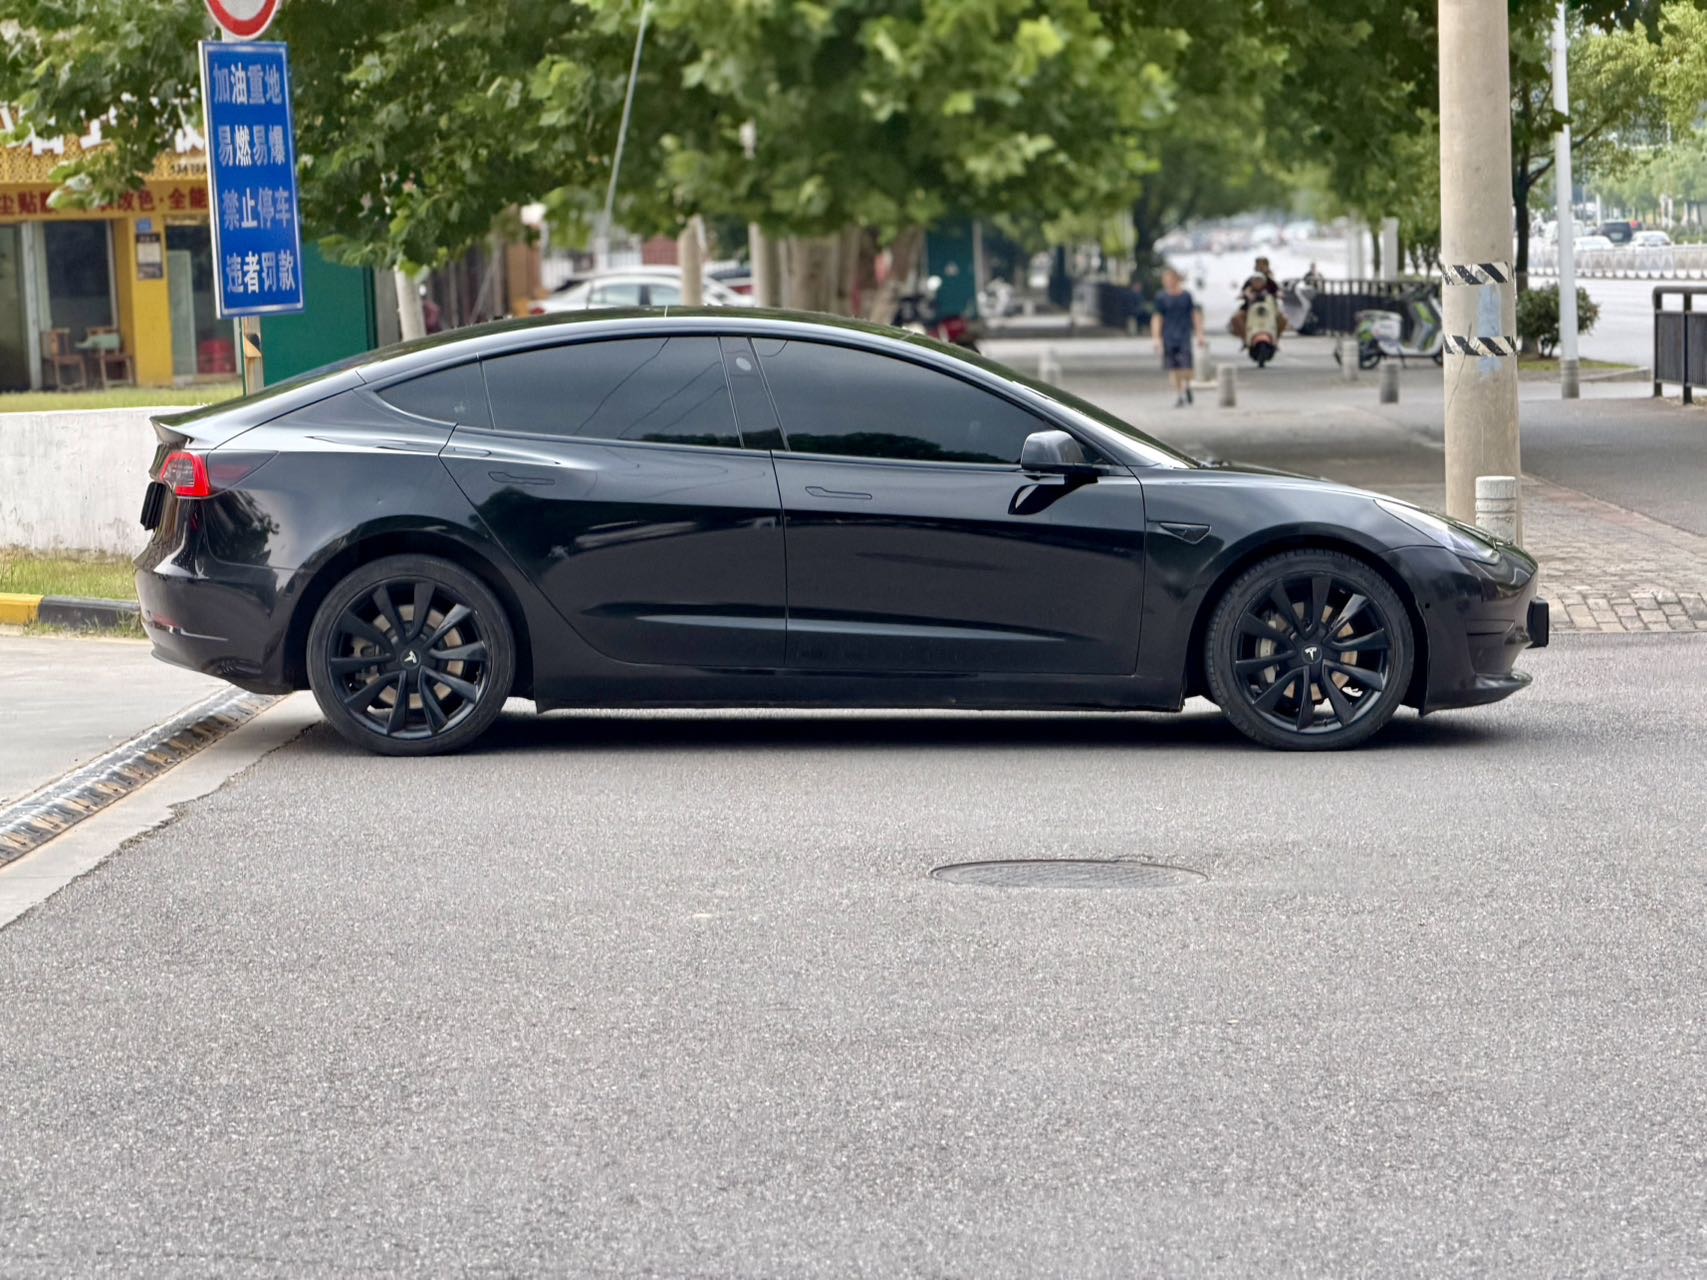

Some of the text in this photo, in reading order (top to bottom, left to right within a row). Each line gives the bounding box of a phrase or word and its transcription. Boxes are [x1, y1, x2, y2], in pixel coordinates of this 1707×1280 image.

[213, 62, 282, 105] 加油重地
[217, 124, 286, 167] 易燃易爆
[222, 186, 291, 231] 禁止停车
[226, 249, 296, 294] 违者罚款
